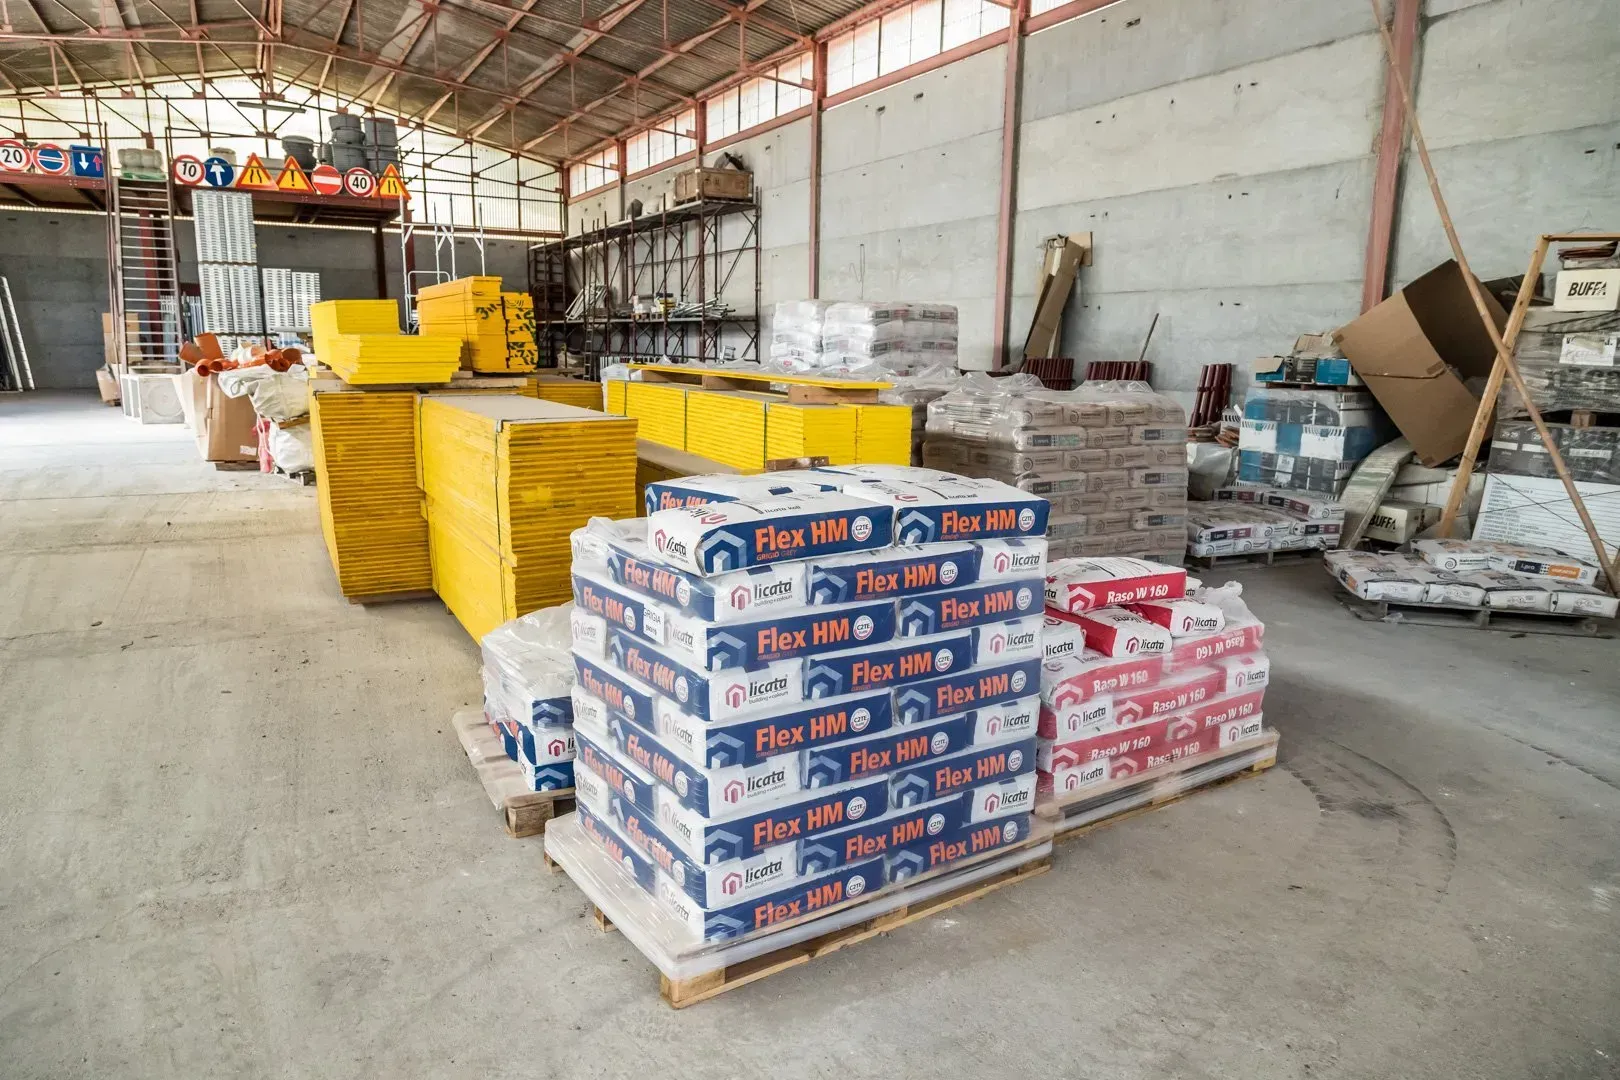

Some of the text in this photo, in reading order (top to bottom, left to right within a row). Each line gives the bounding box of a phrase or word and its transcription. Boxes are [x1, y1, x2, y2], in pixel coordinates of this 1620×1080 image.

[2, 148, 23, 164] 20
[182, 162, 196, 178] 10
[352, 176, 367, 190] 40
[661, 492, 684, 510] Flex
[942, 510, 981, 534] Flex
[986, 509, 1016, 531] HM
[755, 526, 806, 552] Flex
[810, 518, 848, 545] HM
[1012, 553, 1040, 565] licata
[624, 558, 650, 588] Flex
[652, 568, 676, 598] HM
[754, 580, 792, 598] licata
[856, 569, 898, 594] Flex
[904, 564, 936, 588] HM
[942, 598, 979, 621] Flex
[984, 590, 1014, 614] HM
[1107, 584, 1168, 604] Raso W 160
[605, 596, 623, 624] HM
[1195, 617, 1217, 627] licata
[673, 629, 693, 646] licata
[758, 627, 806, 654] Flex
[812, 618, 849, 645] HM
[1007, 633, 1034, 645] licata
[1140, 638, 1164, 650] licata
[1226, 635, 1245, 648] Raso
[1046, 642, 1074, 656] licata
[1196, 646, 1212, 659] 160
[653, 662, 676, 693] HM
[852, 660, 894, 685] Flex
[900, 652, 932, 677] HM
[1247, 670, 1265, 680] licata
[750, 677, 788, 696] licata
[937, 684, 975, 708] Flex
[979, 674, 1008, 698] HM
[1094, 670, 1148, 693] Raso W 160
[605, 682, 623, 709] HM
[1153, 688, 1206, 713] Raso W 160
[1003, 714, 1030, 728] licata
[1083, 707, 1106, 722] licata
[1205, 703, 1253, 727] Raso W 160
[673, 720, 692, 743] licata
[756, 725, 804, 751] Flex
[810, 712, 847, 740] HM
[1241, 723, 1259, 735] licata
[850, 748, 891, 774] Flex
[896, 736, 928, 763] HM
[1091, 736, 1151, 760] Raso W 160
[1184, 742, 1200, 756] 160
[653, 752, 674, 785] HM
[936, 767, 972, 791] Flex
[977, 754, 1005, 779] HM
[1081, 768, 1103, 782] licata
[747, 770, 785, 791] licata
[1002, 790, 1028, 805] licata
[672, 811, 692, 840] licata
[754, 818, 801, 845] Flex
[807, 801, 843, 830] HM
[846, 835, 887, 860] Flex
[892, 818, 924, 846] HM
[929, 826, 1000, 865] Flex HM
[746, 861, 782, 882] licata
[755, 902, 801, 929] Flex
[807, 881, 843, 910] HM
